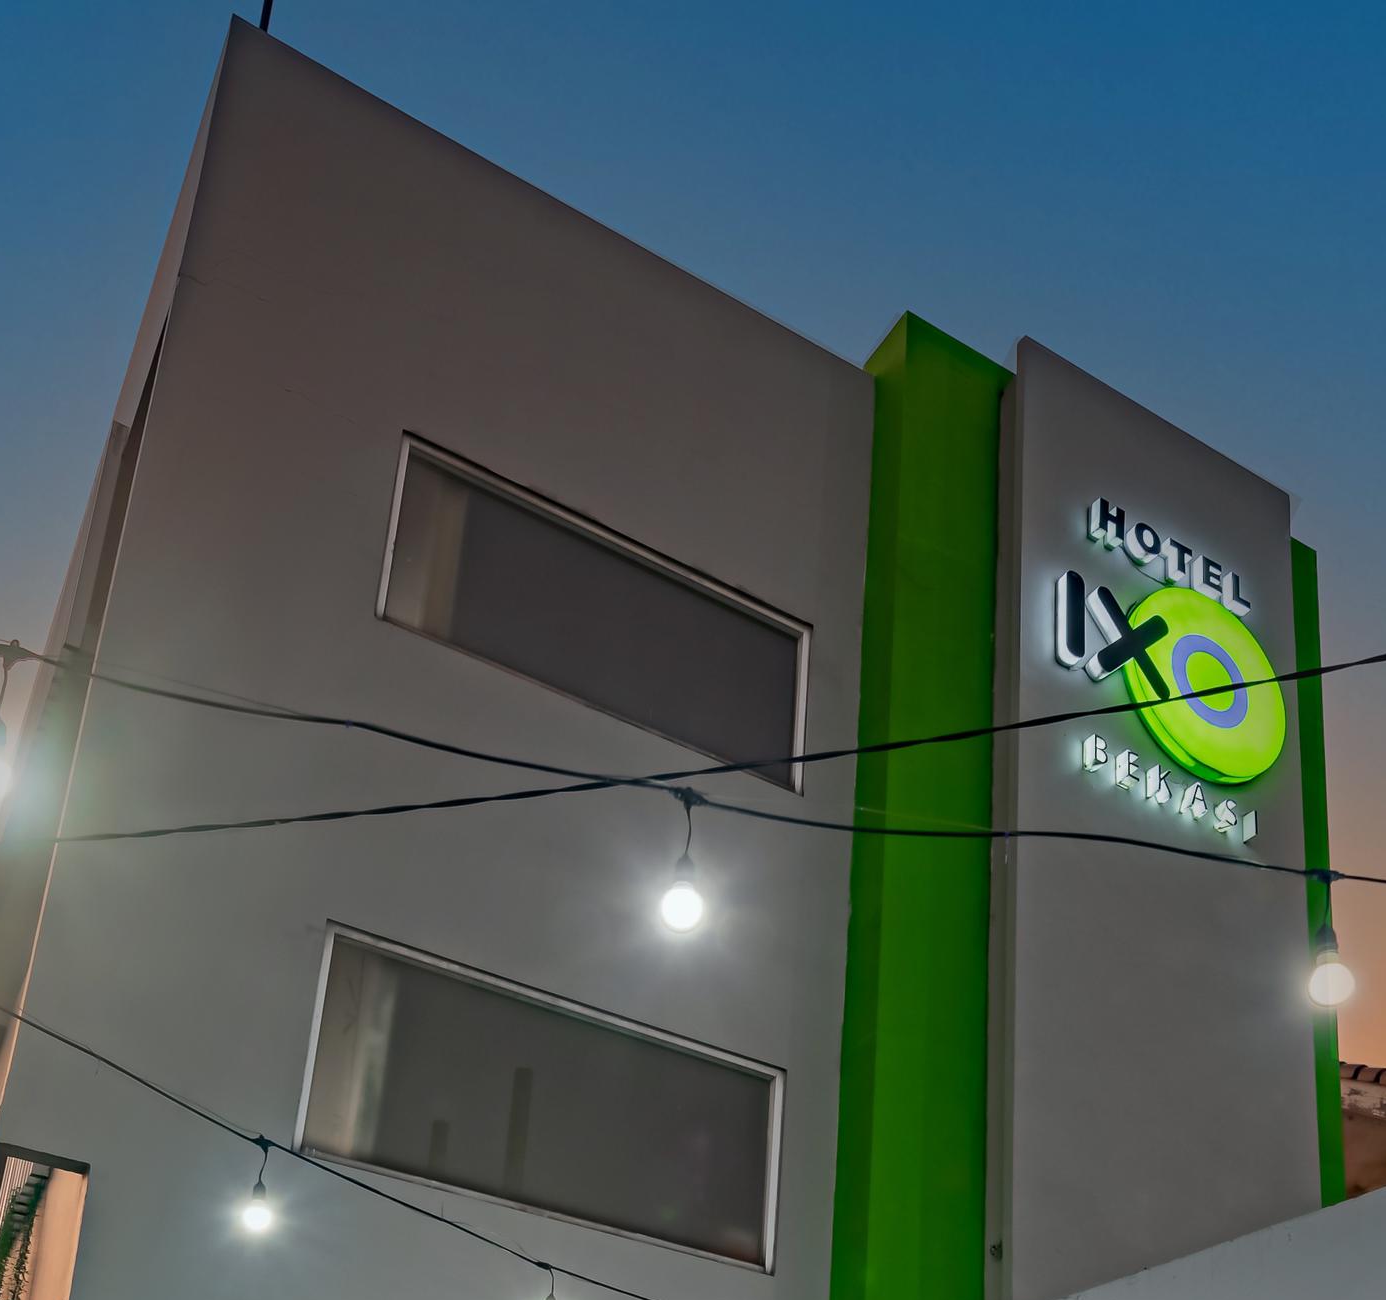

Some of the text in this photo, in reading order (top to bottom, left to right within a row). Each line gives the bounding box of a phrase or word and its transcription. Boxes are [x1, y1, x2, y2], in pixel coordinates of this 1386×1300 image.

[1087, 497, 1252, 617] HOTEL
[1055, 570, 1249, 729] IXO
[1082, 733, 1258, 844] BEKASI
